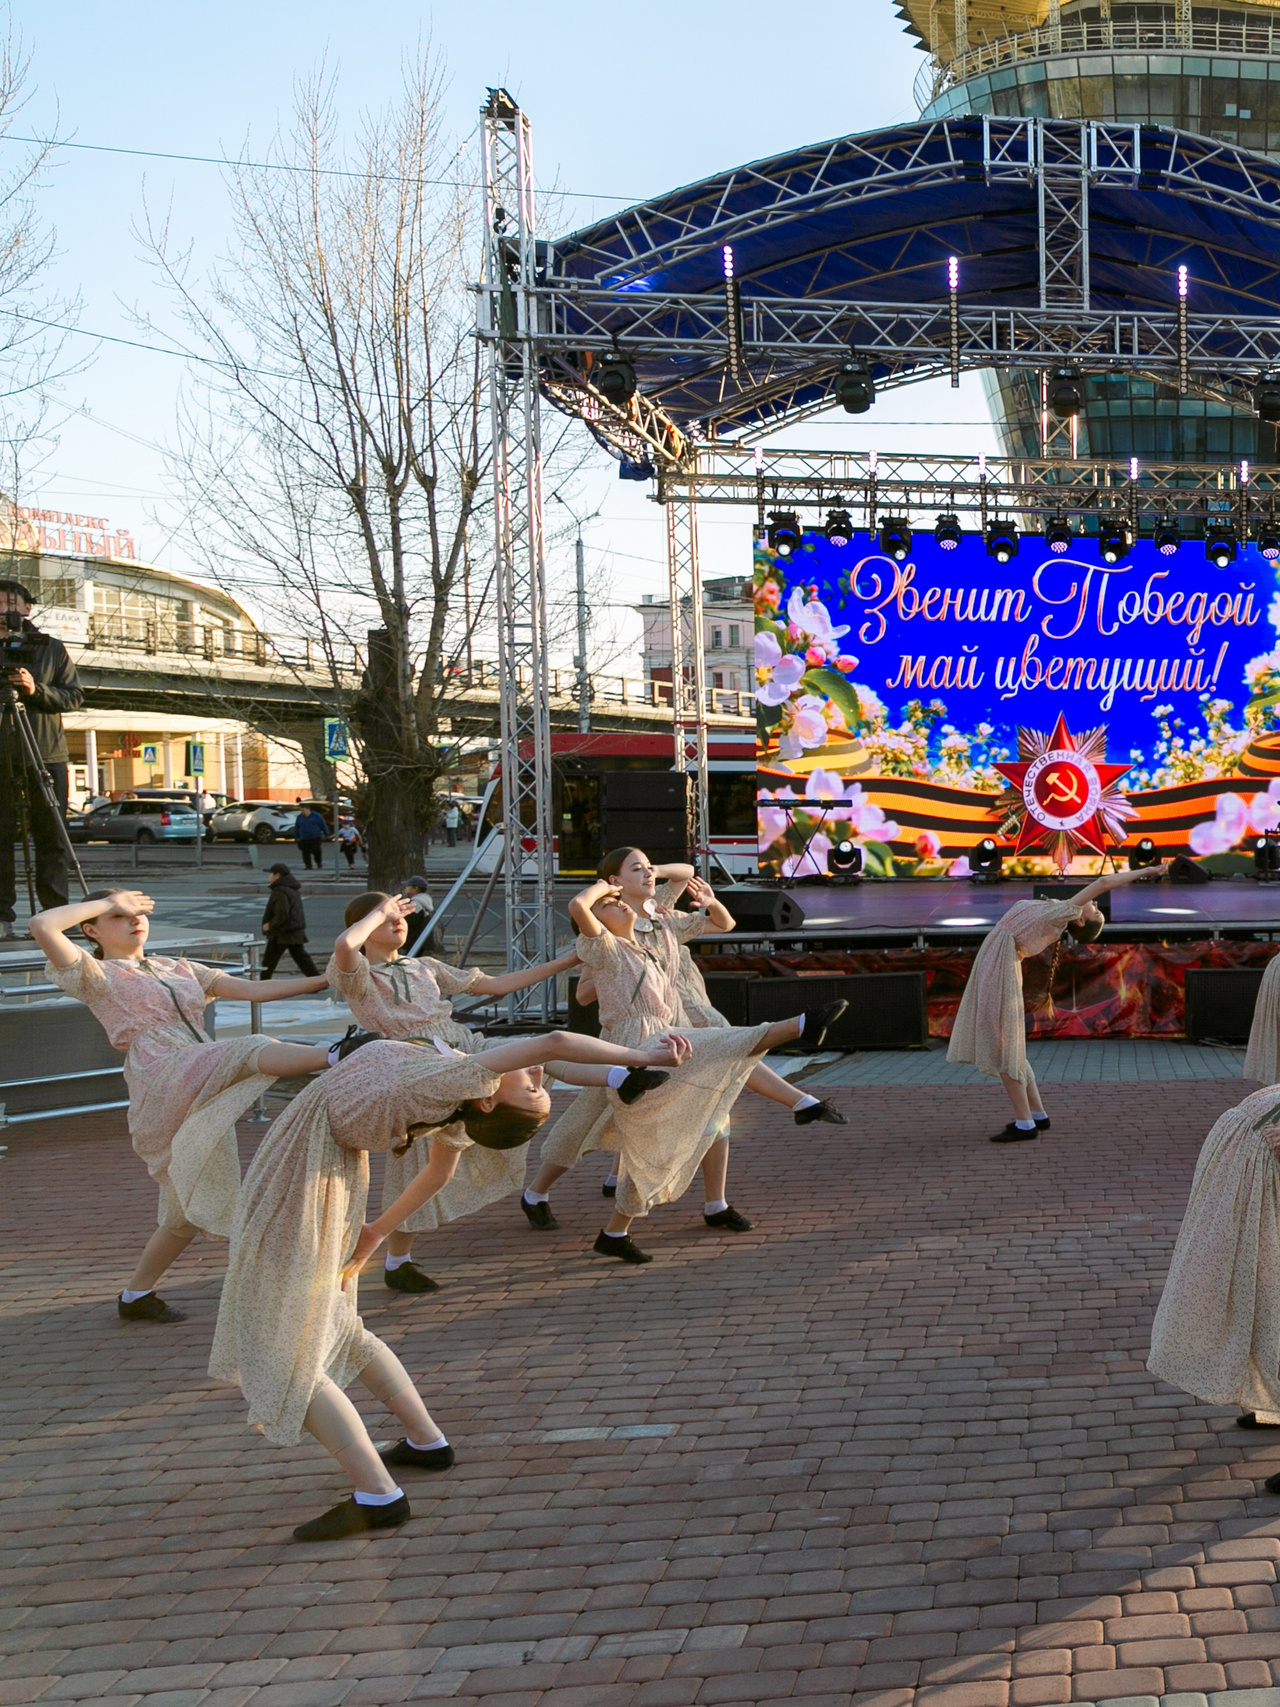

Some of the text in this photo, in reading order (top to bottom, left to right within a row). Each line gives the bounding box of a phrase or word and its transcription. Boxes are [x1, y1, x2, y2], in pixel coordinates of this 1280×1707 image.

[7, 505, 110, 531] КОМПЛЕКС
[849, 555, 1261, 646] Звенит Победой
[886, 633, 1230, 712] май цветущий!
[1024, 751, 1092, 822] ОТЕЧЕСТВЕННАЯ
